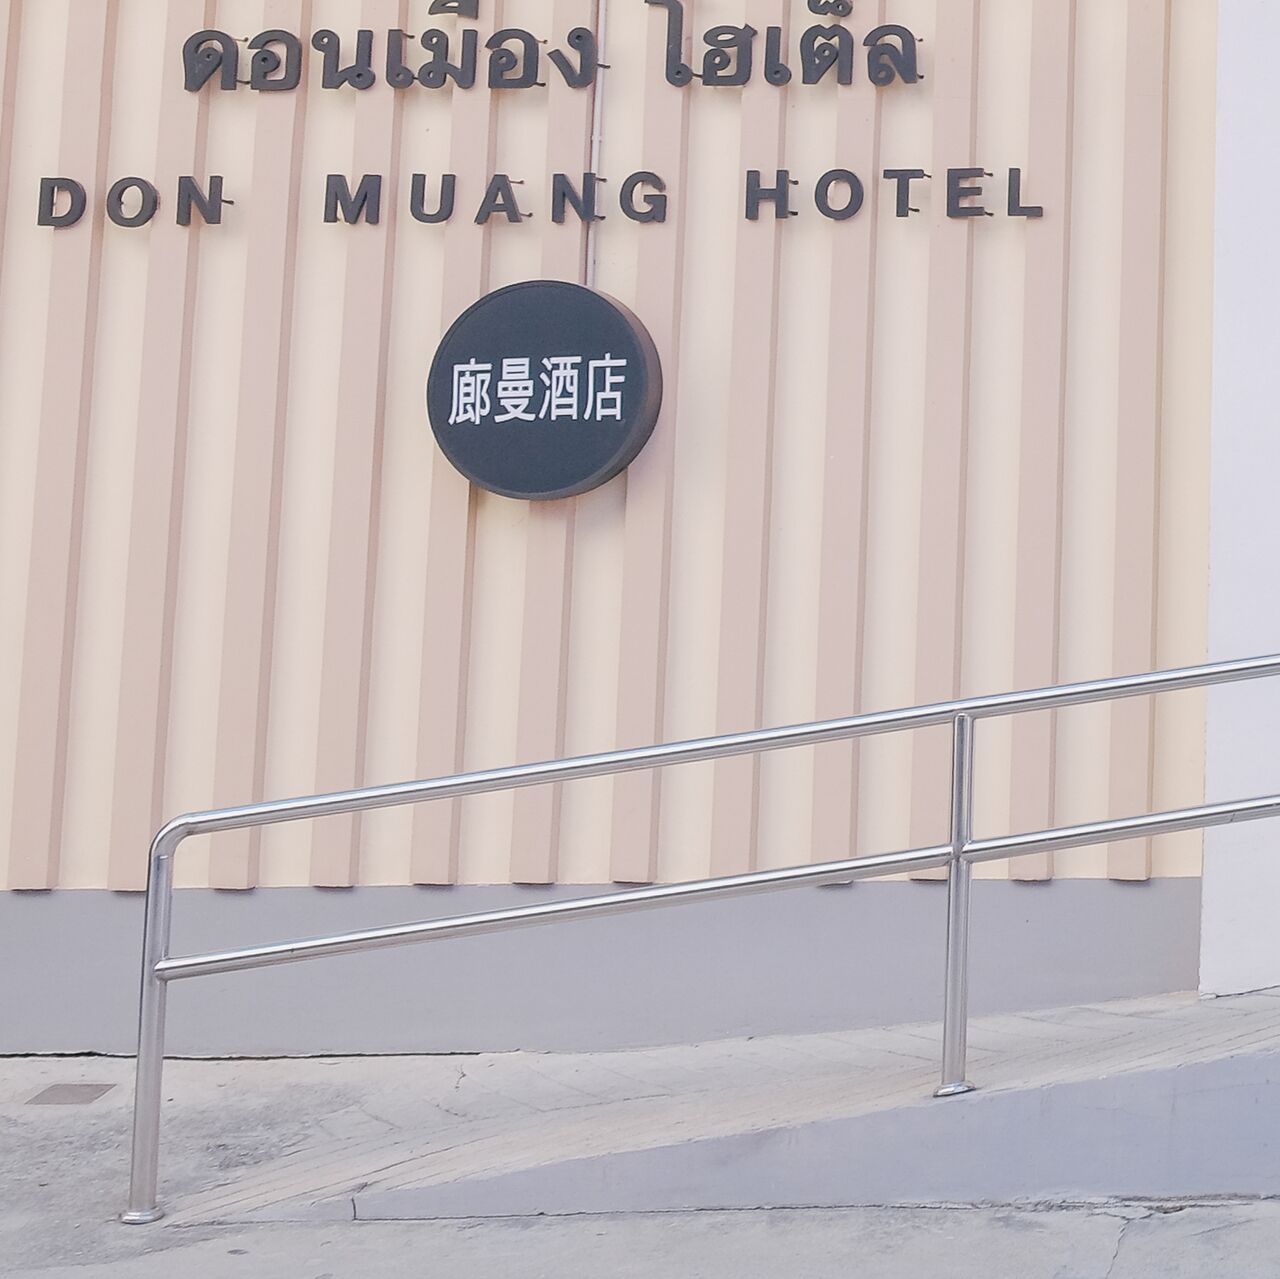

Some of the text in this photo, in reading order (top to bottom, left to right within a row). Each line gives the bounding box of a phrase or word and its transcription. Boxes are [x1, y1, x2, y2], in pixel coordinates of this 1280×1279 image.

[36, 167, 1044, 228] DON MUANG HOTEL
[447, 352, 628, 426] 廊曼酒店
